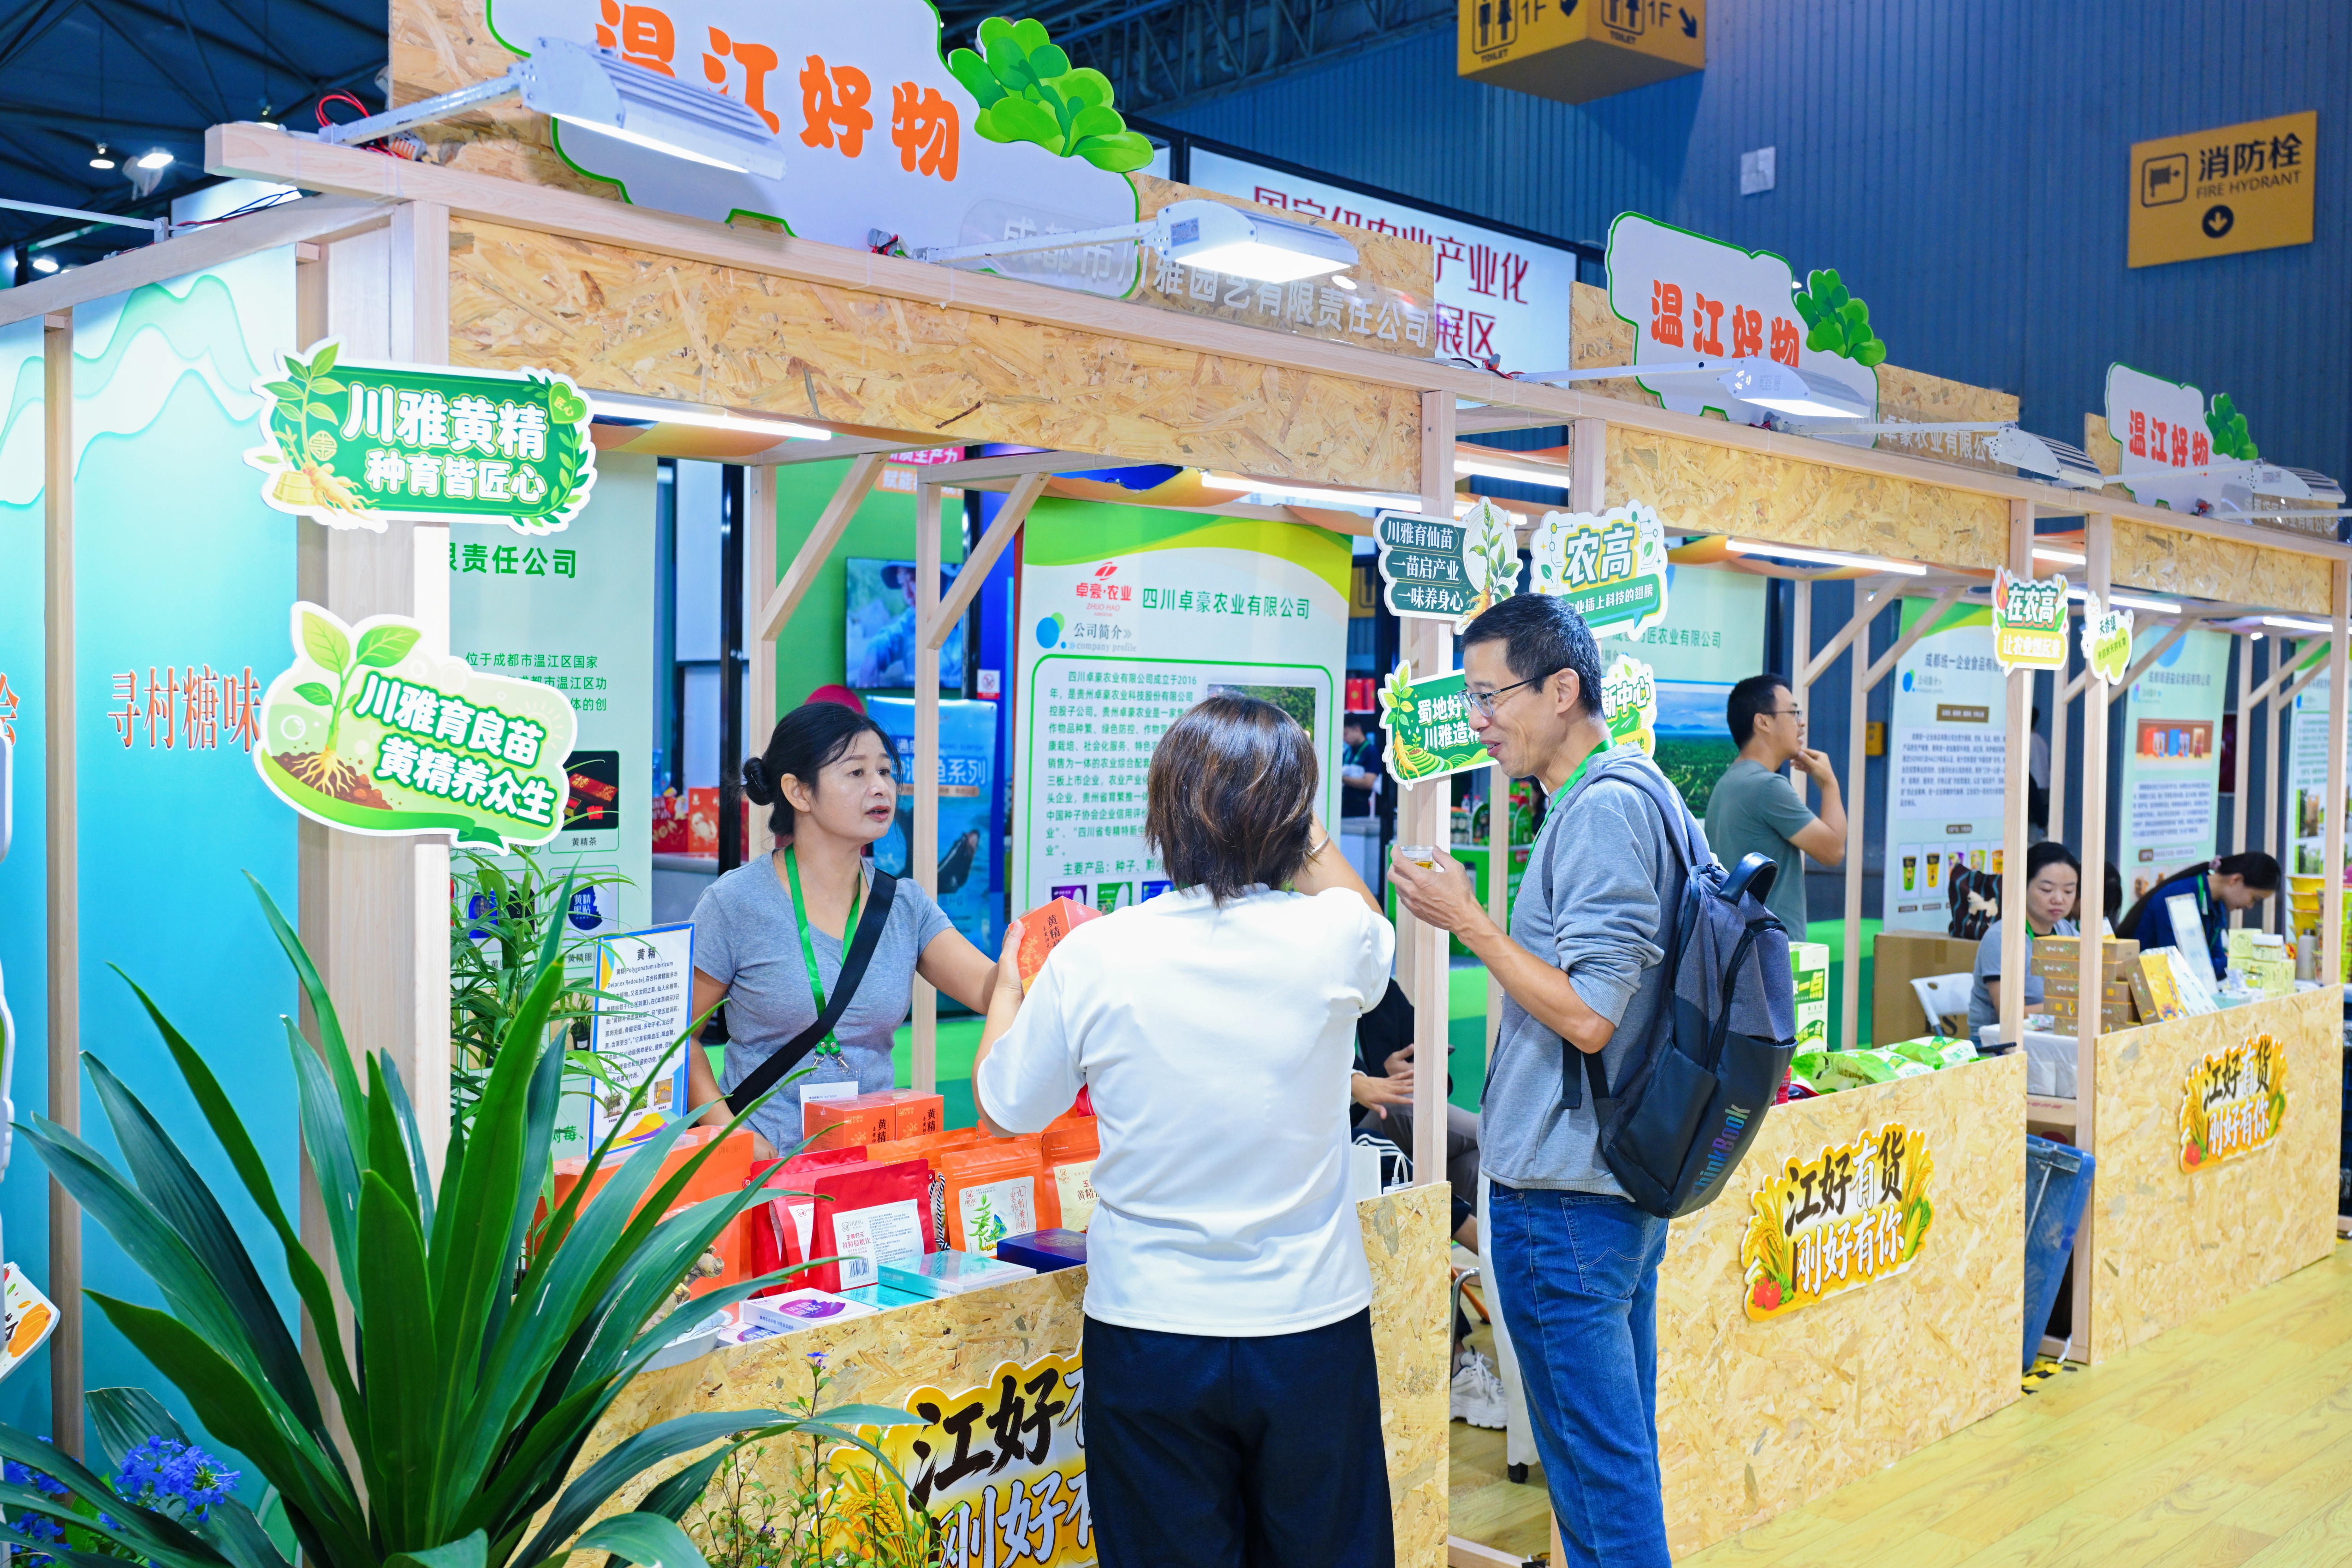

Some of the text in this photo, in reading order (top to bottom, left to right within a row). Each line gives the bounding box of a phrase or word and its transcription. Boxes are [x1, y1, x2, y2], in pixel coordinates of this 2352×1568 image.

[1610, 31, 1636, 44] TOILET
[1481, 48, 1509, 63] TOILET
[2198, 132, 2302, 182] 消防栓
[2197, 171, 2302, 199] FIRE HYDRANT
[1651, 279, 1800, 368] 温江好物
[342, 382, 547, 461] 川雅黄精
[554, 398, 575, 417] 匠心
[2129, 409, 2209, 477] 温江好物
[367, 450, 546, 504] 种育皆匠心
[1386, 520, 1453, 550] 川雅育仙苗
[1392, 556, 1459, 582] 一苗启产业
[1565, 524, 1635, 584] 农高
[1142, 588, 1310, 619] 四川卓豪农业有限公司
[1397, 587, 1464, 612] 一味养身心
[2007, 587, 2058, 623] 在农高
[1074, 623, 1122, 640] 公司简介
[466, 653, 598, 669] 位于成都市温江区国家
[1077, 643, 1137, 652] company profile
[108, 664, 262, 754] 寻村糖味
[355, 674, 544, 767] 川雅育良苗
[376, 737, 555, 824] 黄精养众生
[572, 837, 597, 847] 黄精茶
[568, 952, 594, 963] 黄精眼
[637, 947, 656, 961] 黄精
[2204, 1039, 2271, 1112] 江好有货
[2206, 1095, 2269, 1157] 刚好有你
[1784, 1130, 1905, 1237] 江好有货
[1017, 1188, 1027, 1230] 九制黄精
[843, 1237, 871, 1249] 黄精稳糖饮
[846, 1232, 865, 1240] 玉黄归元
[1791, 1204, 1905, 1296] 刚好有你
